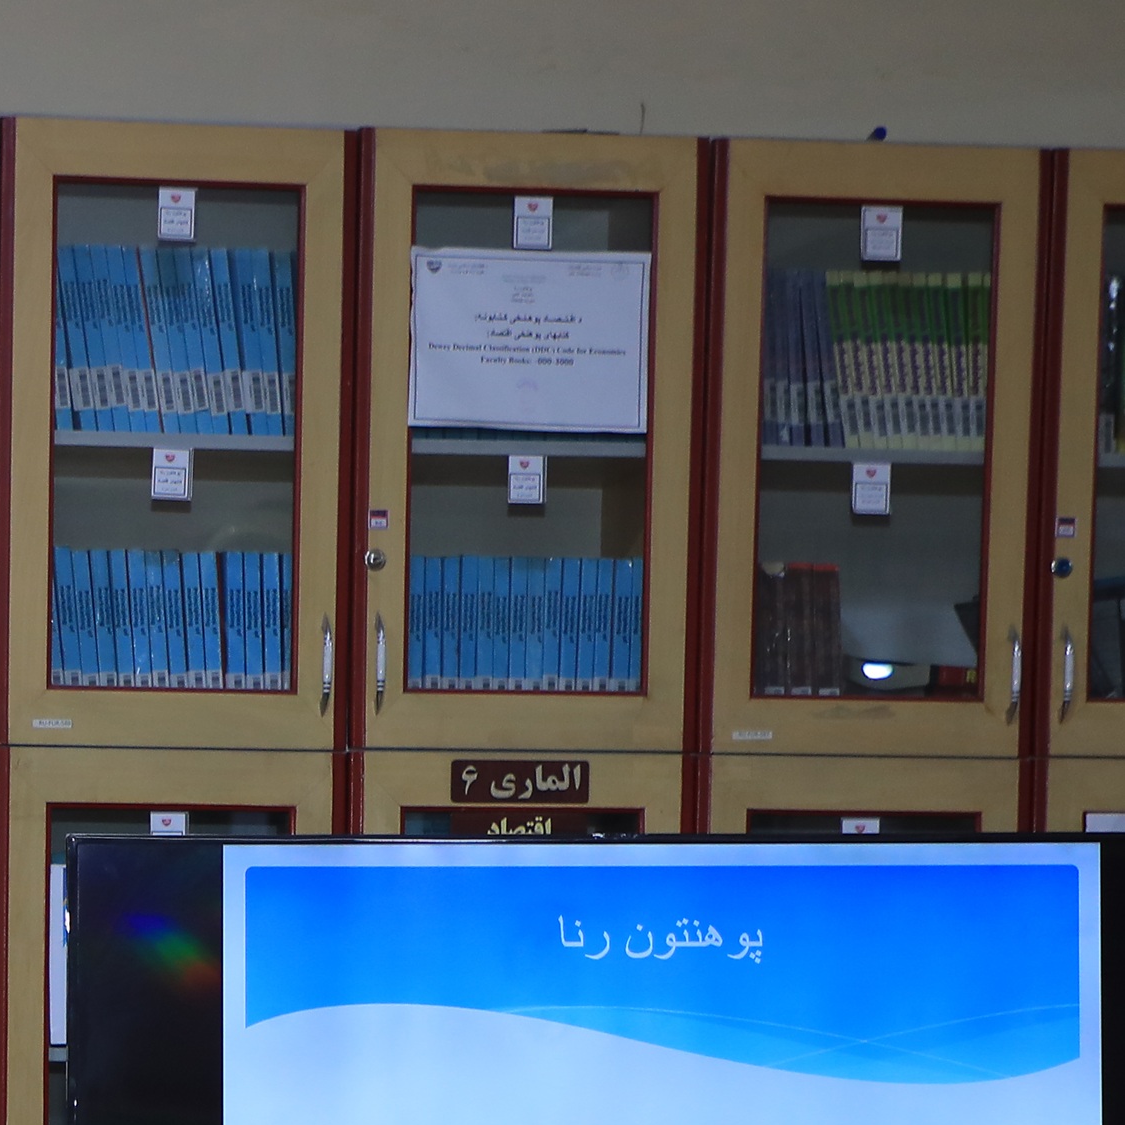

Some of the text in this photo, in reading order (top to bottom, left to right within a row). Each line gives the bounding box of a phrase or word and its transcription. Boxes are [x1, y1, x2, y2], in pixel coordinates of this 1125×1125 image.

[461, 763, 581, 800] الماری ۶
[486, 816, 552, 835] اقتصاد
[558, 915, 610, 960] رنا
